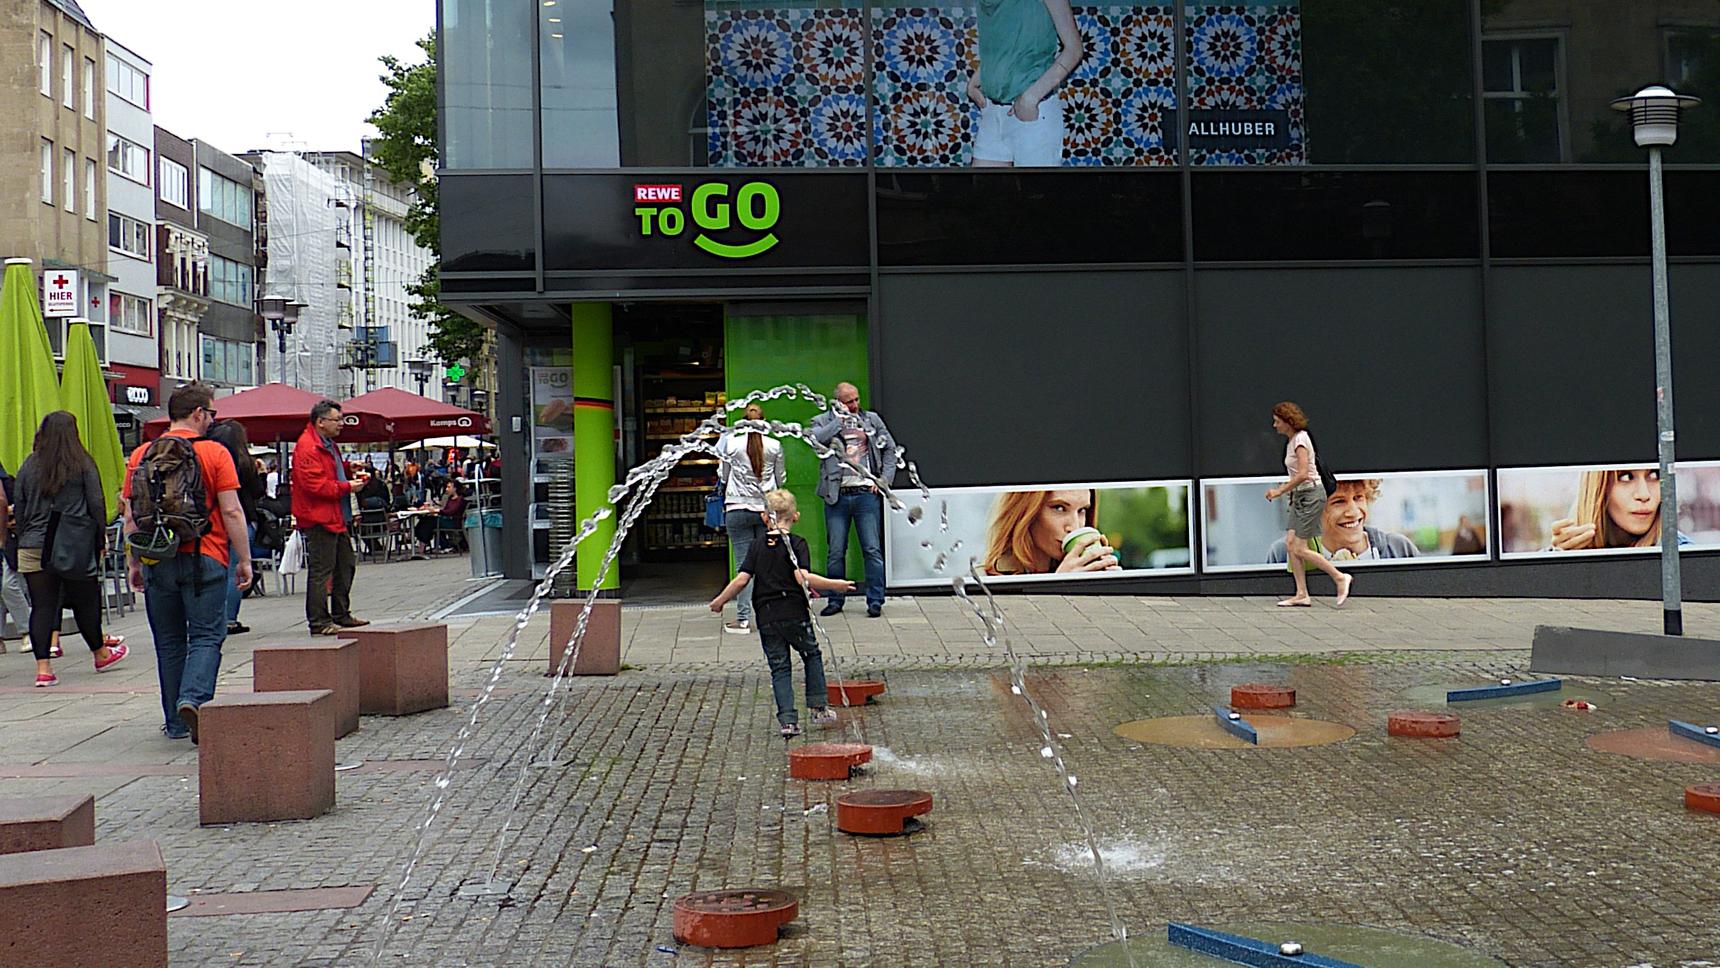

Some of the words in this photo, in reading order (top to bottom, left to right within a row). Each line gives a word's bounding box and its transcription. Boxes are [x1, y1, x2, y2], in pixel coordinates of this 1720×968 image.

[1188, 122, 1275, 136] ALLHUBER
[637, 187, 681, 200] REWE
[635, 207, 685, 236] TO
[691, 182, 780, 230] GO
[49, 292, 73, 300] HIER
